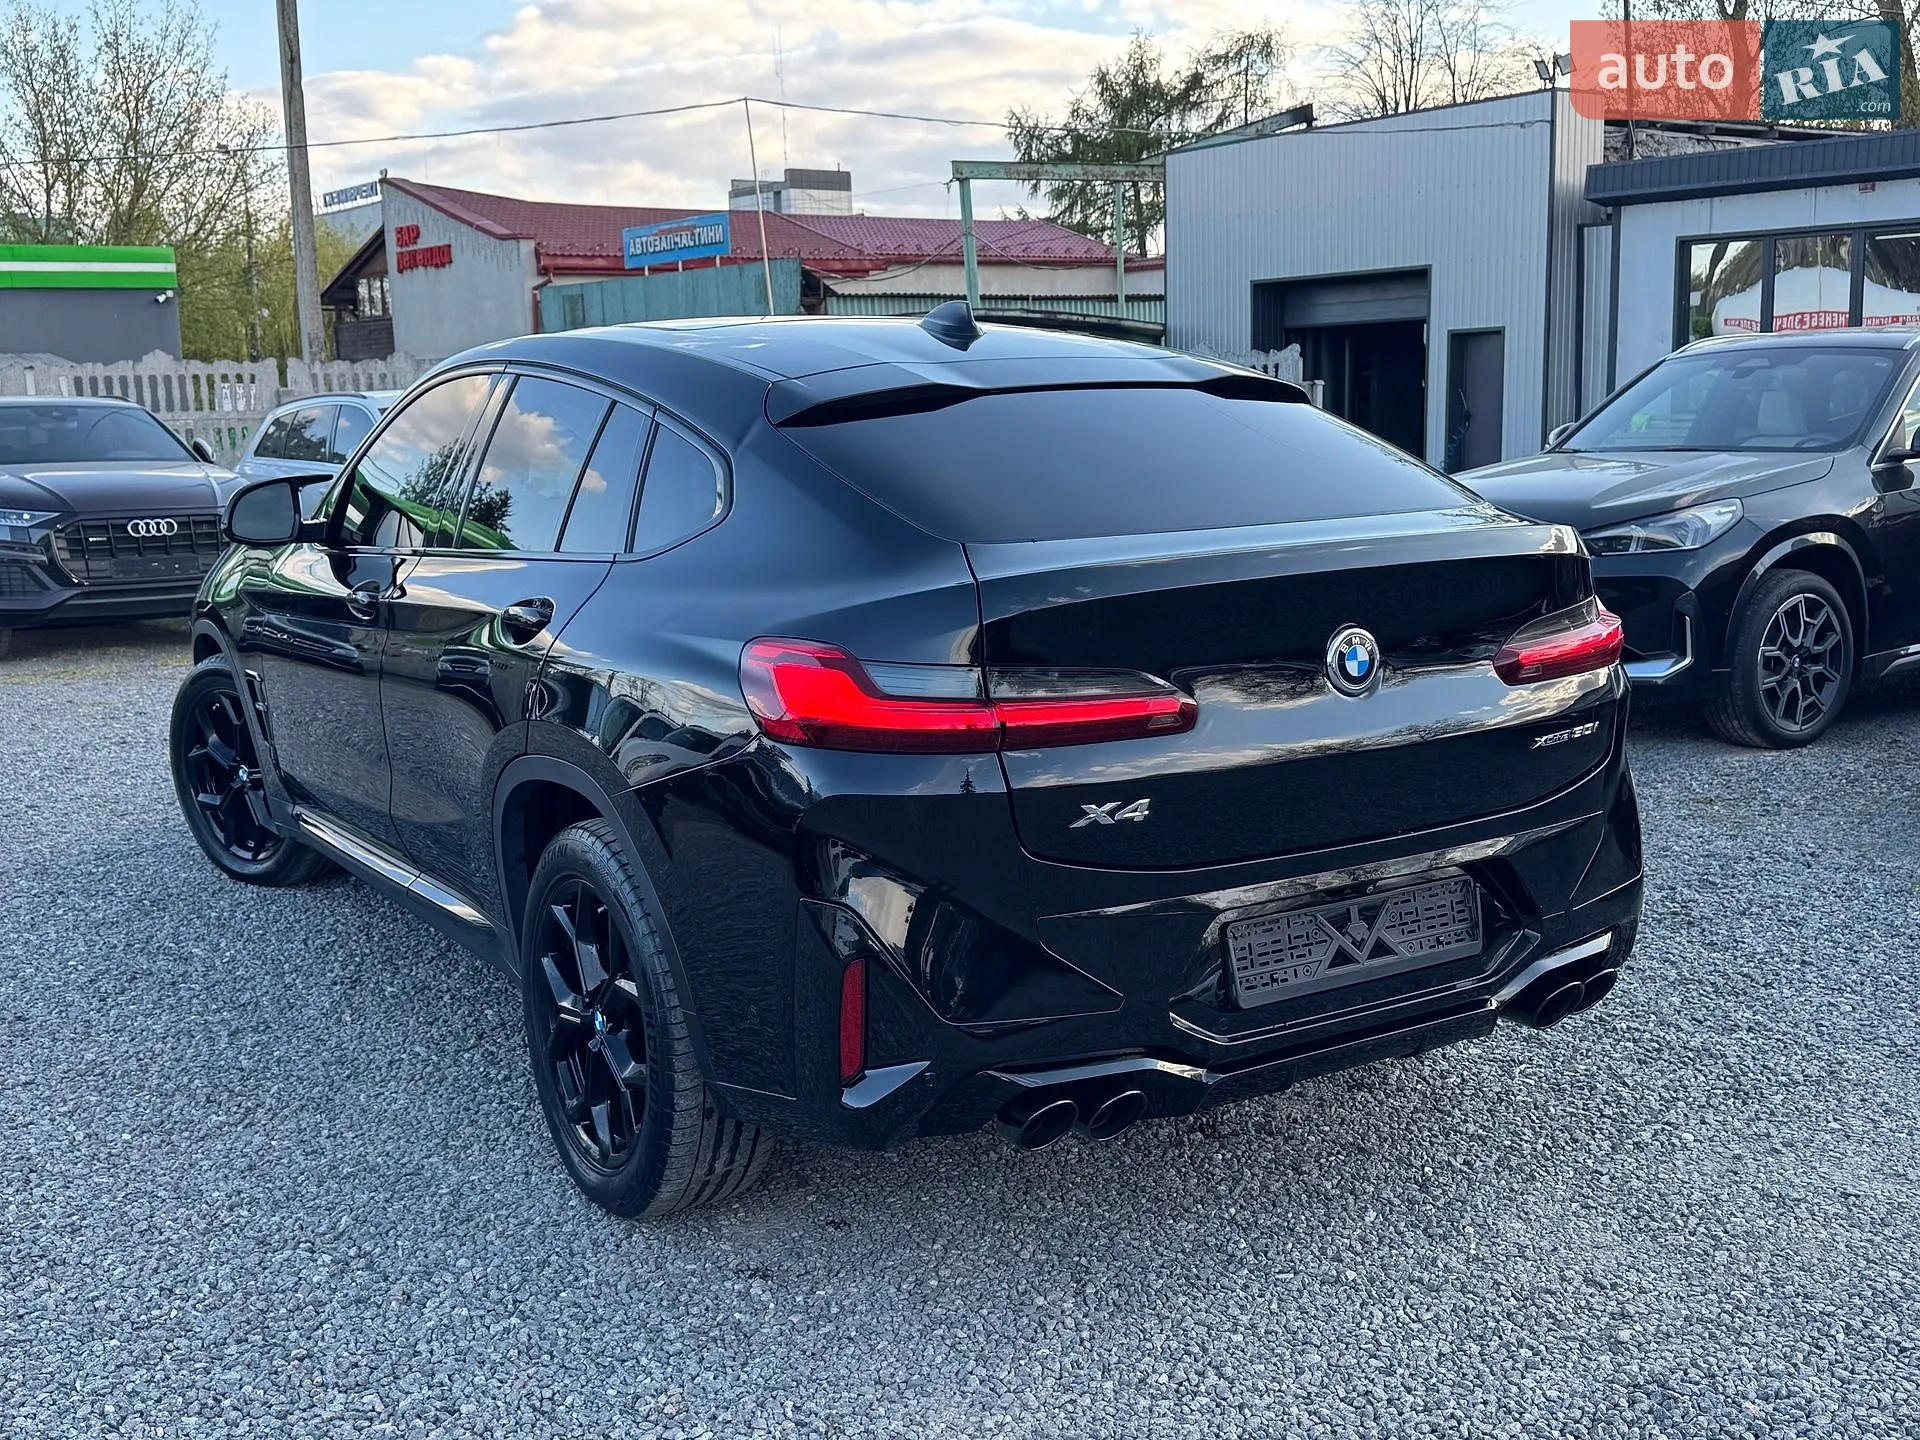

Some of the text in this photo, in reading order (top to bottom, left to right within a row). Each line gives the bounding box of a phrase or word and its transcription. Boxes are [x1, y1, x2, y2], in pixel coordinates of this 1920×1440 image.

[629, 224, 724, 256] АВТОЗАПЧАСТИНИ
[1341, 636, 1373, 654] BMW
[1069, 798, 1151, 828] X4
